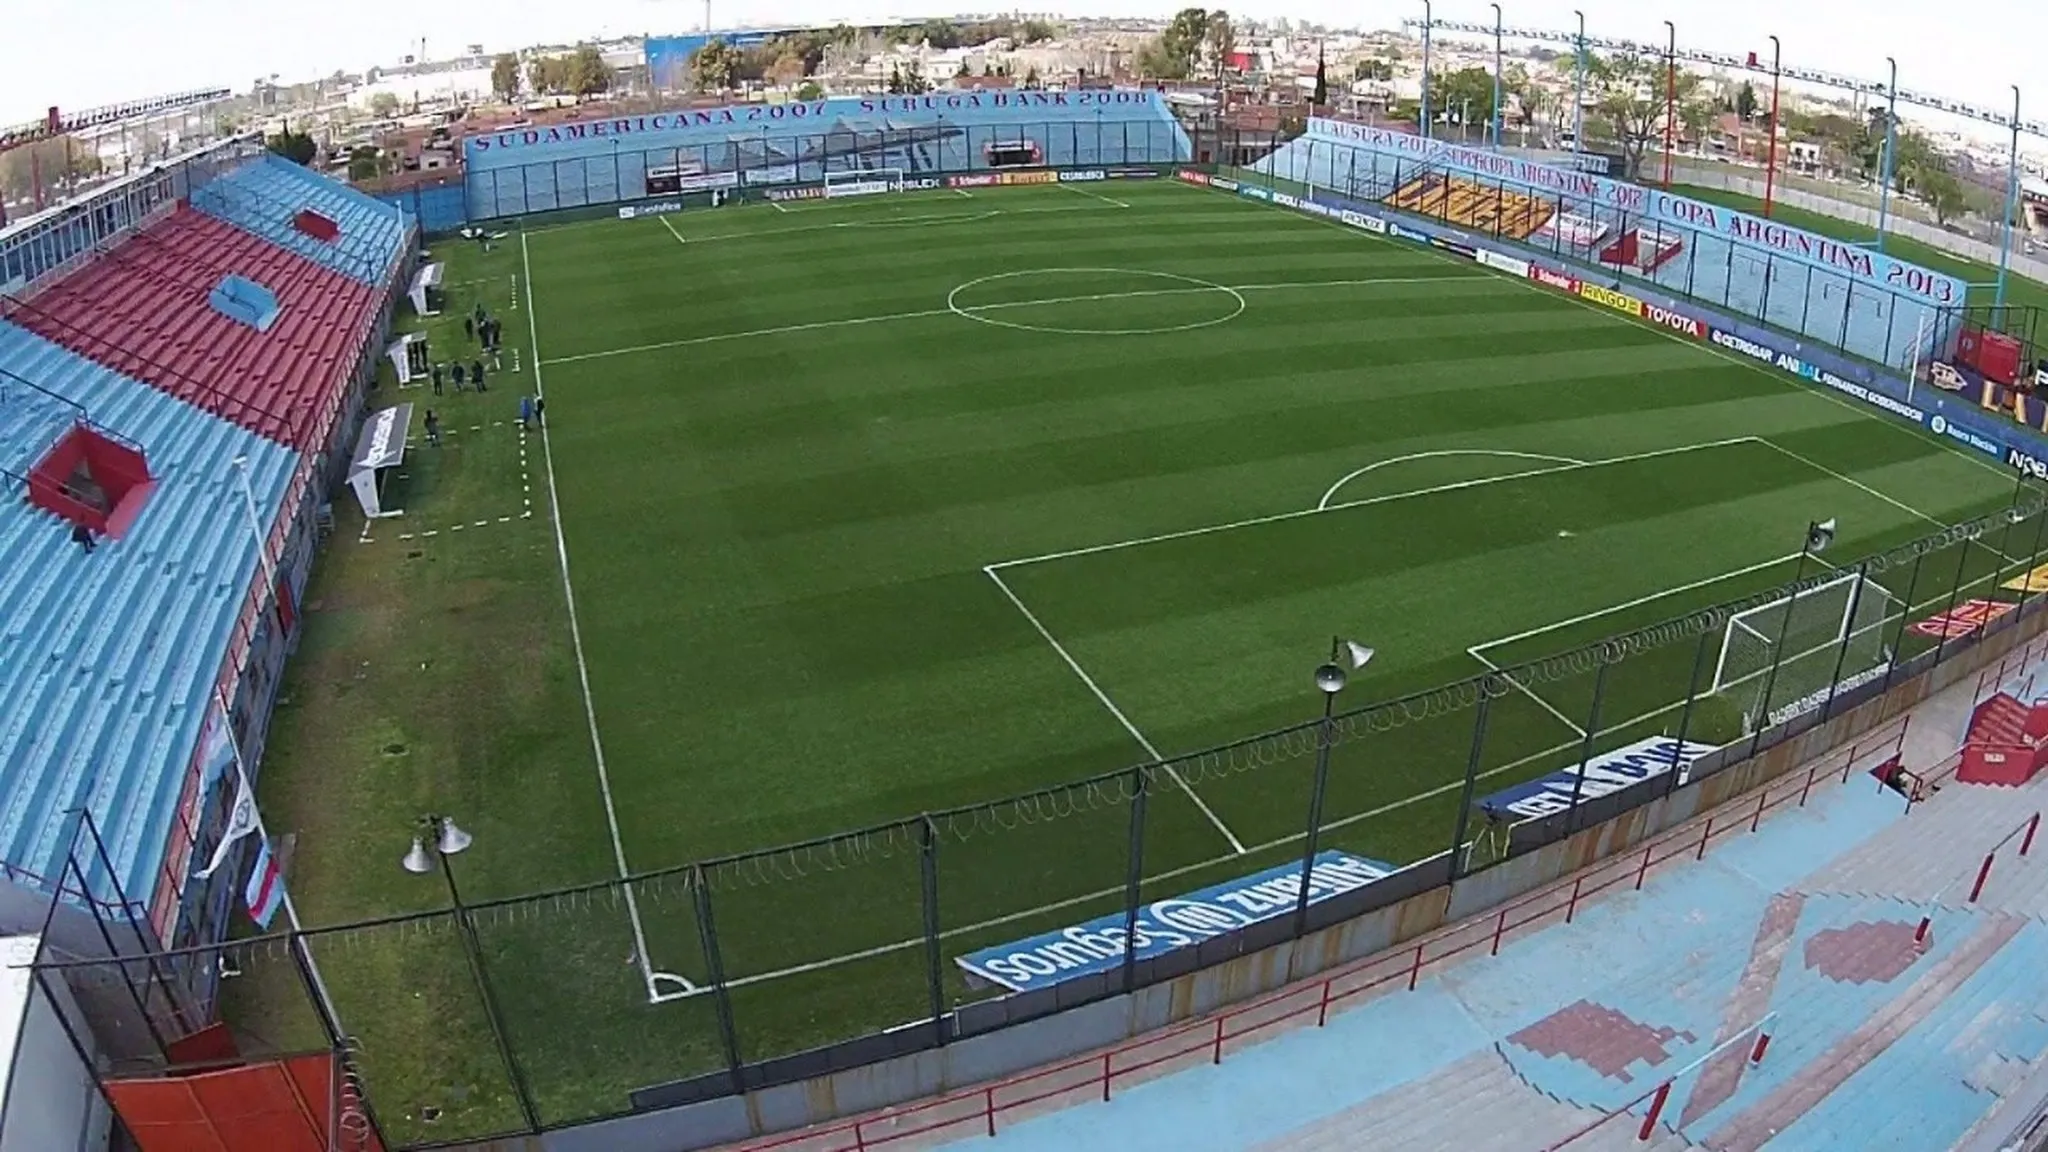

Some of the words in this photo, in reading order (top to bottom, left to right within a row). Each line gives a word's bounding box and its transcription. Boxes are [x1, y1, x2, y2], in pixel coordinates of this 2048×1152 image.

[861, 93, 980, 112] SURUGA
[996, 92, 1069, 107] BANK
[1079, 91, 1147, 104] 2008
[475, 104, 735, 150] SUDAMERICANA
[749, 102, 825, 121] 2007
[1658, 194, 1717, 229] COPA
[1729, 217, 1873, 277] ARGENTINA
[1887, 266, 1953, 302] 2013
[1583, 284, 1627, 309] RINGO
[1646, 304, 1699, 335] TOYOTA
[1722, 332, 1773, 362] CETROGAR
[1776, 353, 1822, 383] ANIBAL
[2009, 449, 2048, 480] NOB
[1217, 857, 1390, 913] Allianz
[984, 919, 1194, 982] Seguros
